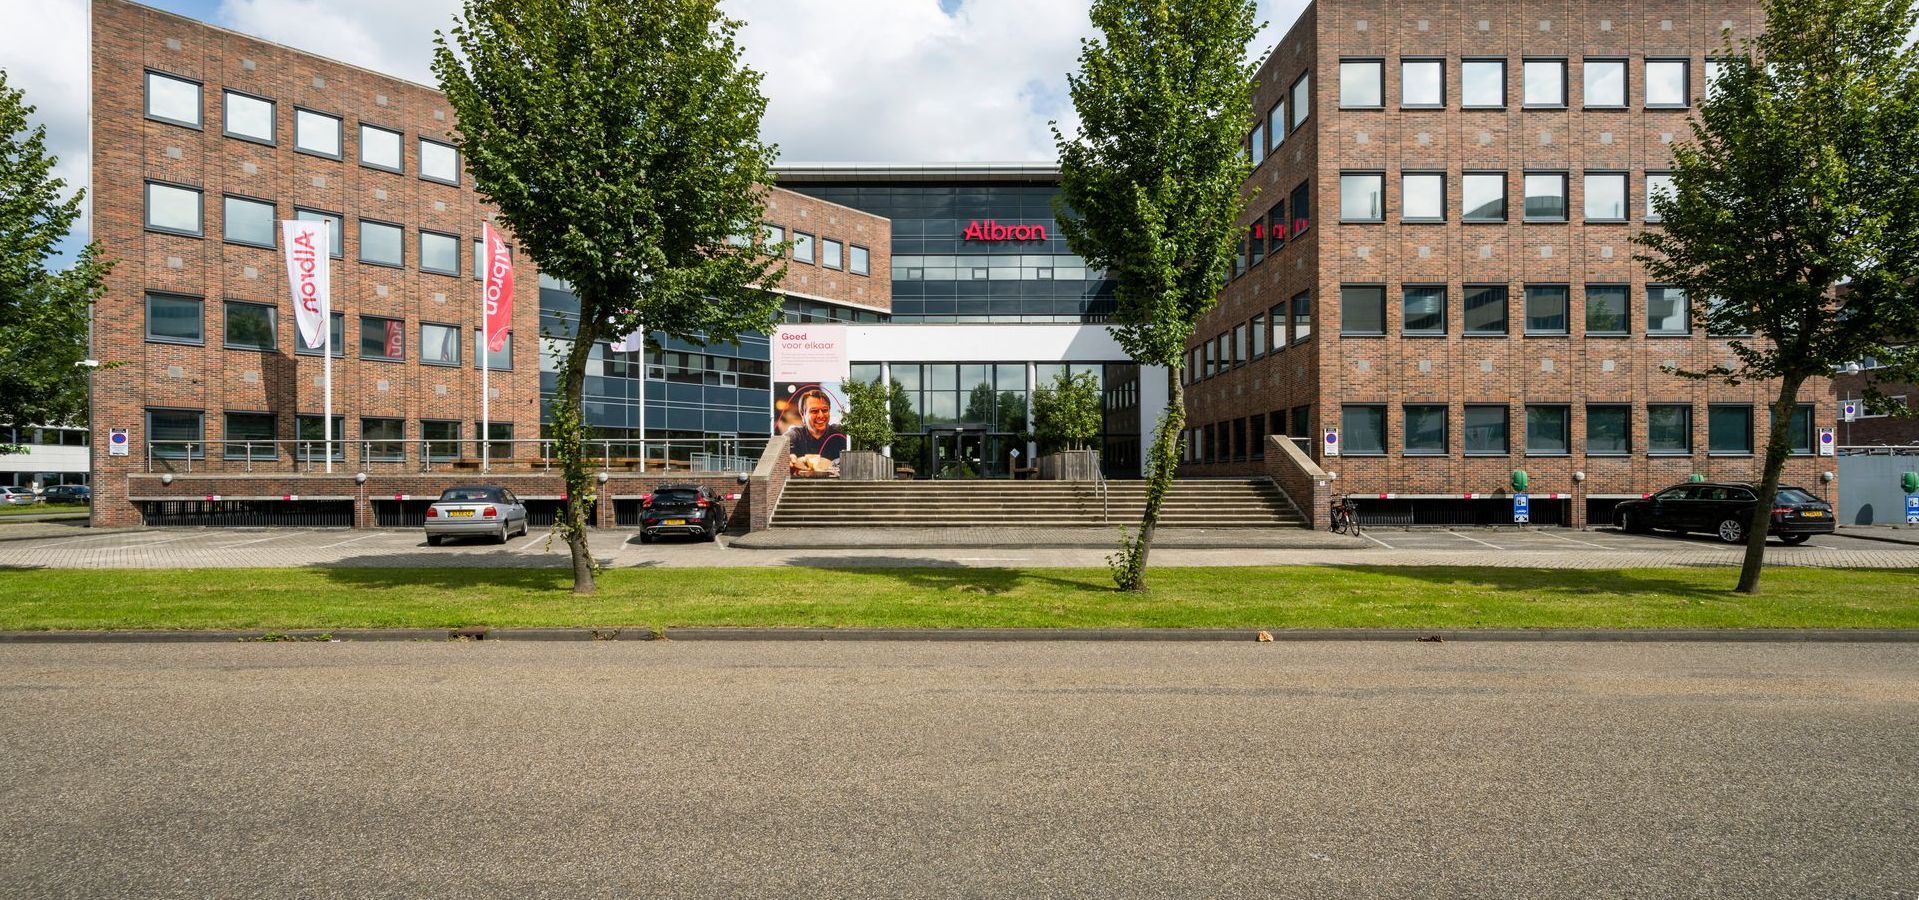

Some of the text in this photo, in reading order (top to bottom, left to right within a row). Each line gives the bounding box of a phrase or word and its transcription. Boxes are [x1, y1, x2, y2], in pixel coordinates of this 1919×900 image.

[964, 219, 1047, 241] Albron
[486, 237, 510, 315] Albron
[781, 332, 807, 341] Goed
[804, 341, 834, 349] elkaar
